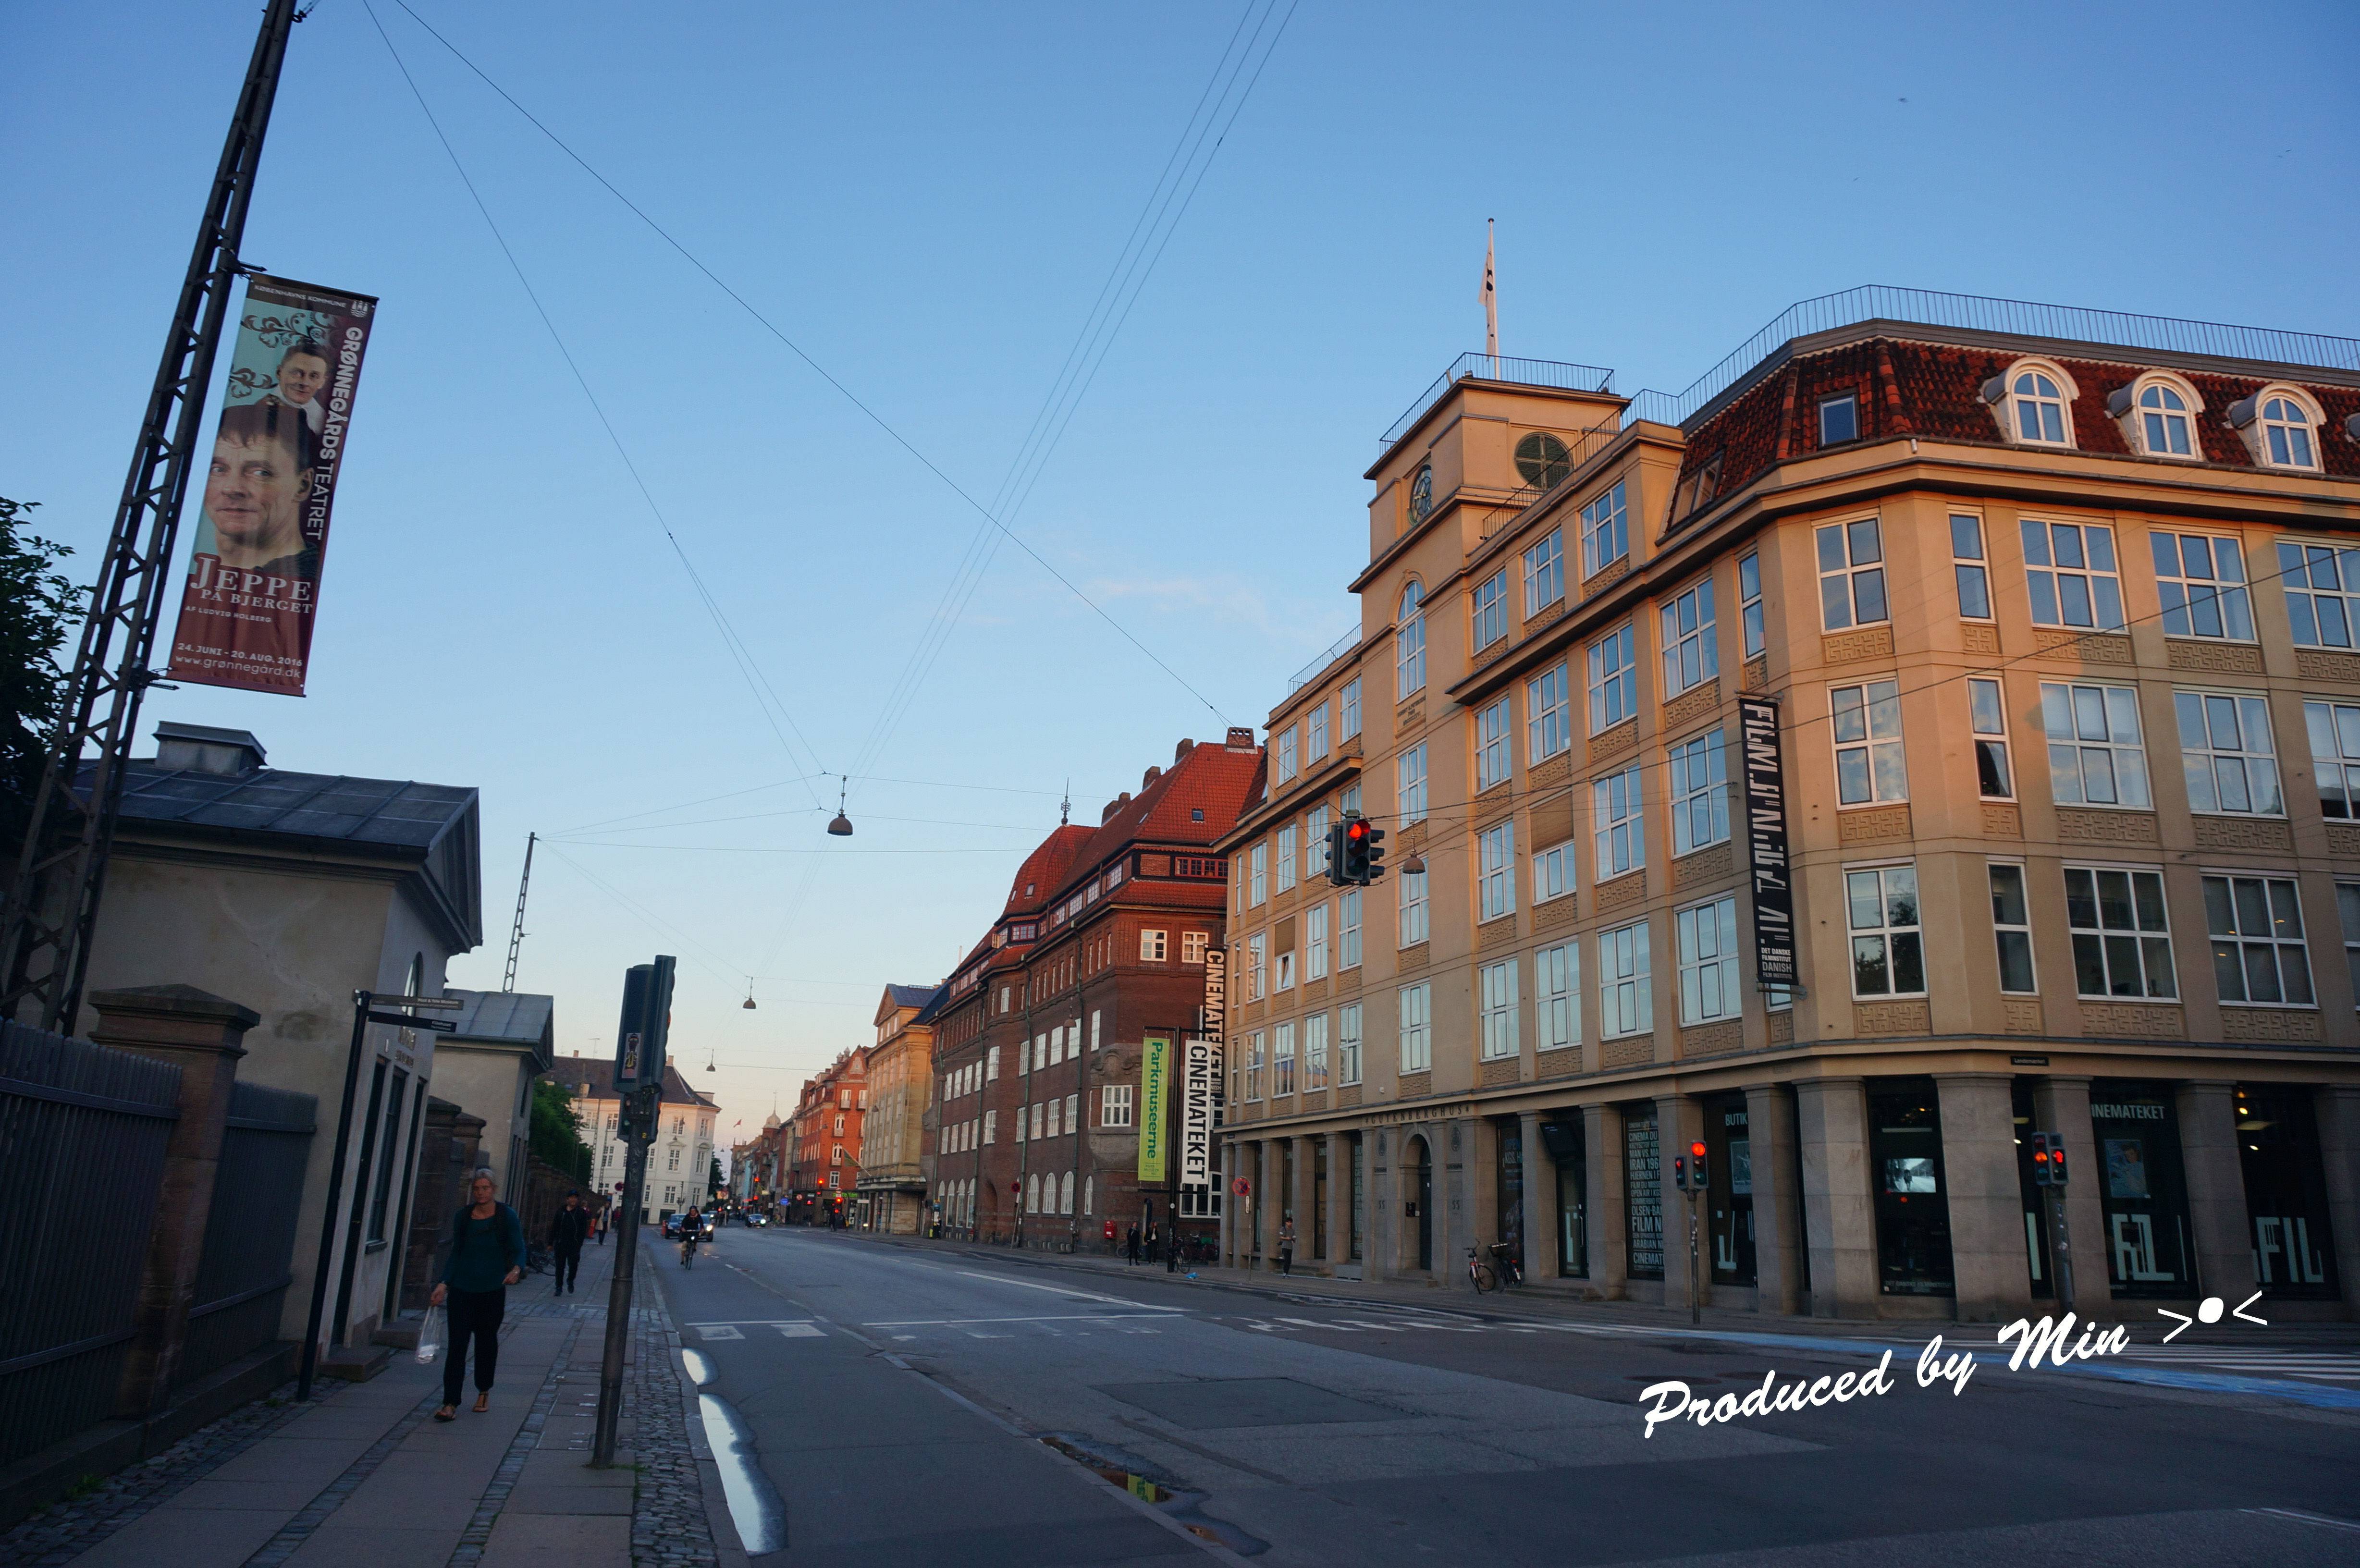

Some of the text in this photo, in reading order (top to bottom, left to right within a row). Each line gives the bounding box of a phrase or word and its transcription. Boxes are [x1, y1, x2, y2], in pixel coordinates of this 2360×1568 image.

[254, 284, 346, 308] KØBENHAVNS KOMMUNE
[306, 327, 363, 541] GRØNNEGÅRDS TEATRET
[200, 587, 313, 614] PÅ BJERGET
[198, 607, 232, 617] LUDVIG
[234, 612, 271, 623] HOLBERG
[177, 643, 194, 652] 24.
[196, 645, 222, 656] JUNI
[231, 650, 247, 659] 20.
[249, 653, 275, 663] AUG.
[277, 657, 303, 667] 2016
[1761, 954, 1791, 963] FILMINSTITUT
[1771, 948, 1791, 956] DANSKE
[1762, 961, 1792, 973] DANISH
[1205, 950, 1224, 1077] CINEMATEKET
[1147, 1041, 1163, 1159] Parkmuseerne
[1187, 1045, 1207, 1179] CINEMATEKET
[1371, 1105, 1462, 1125] GUTENBERGHUS
[1725, 1113, 1748, 1126] BUTIK
[2091, 1104, 2165, 1119] INEMATEKET
[1628, 1131, 1658, 1142] CINEMA DU
[1630, 1158, 1660, 1170] IRAN 196
[1632, 1216, 1653, 1232] FILM
[1633, 1239, 1656, 1250] ARABIAN
